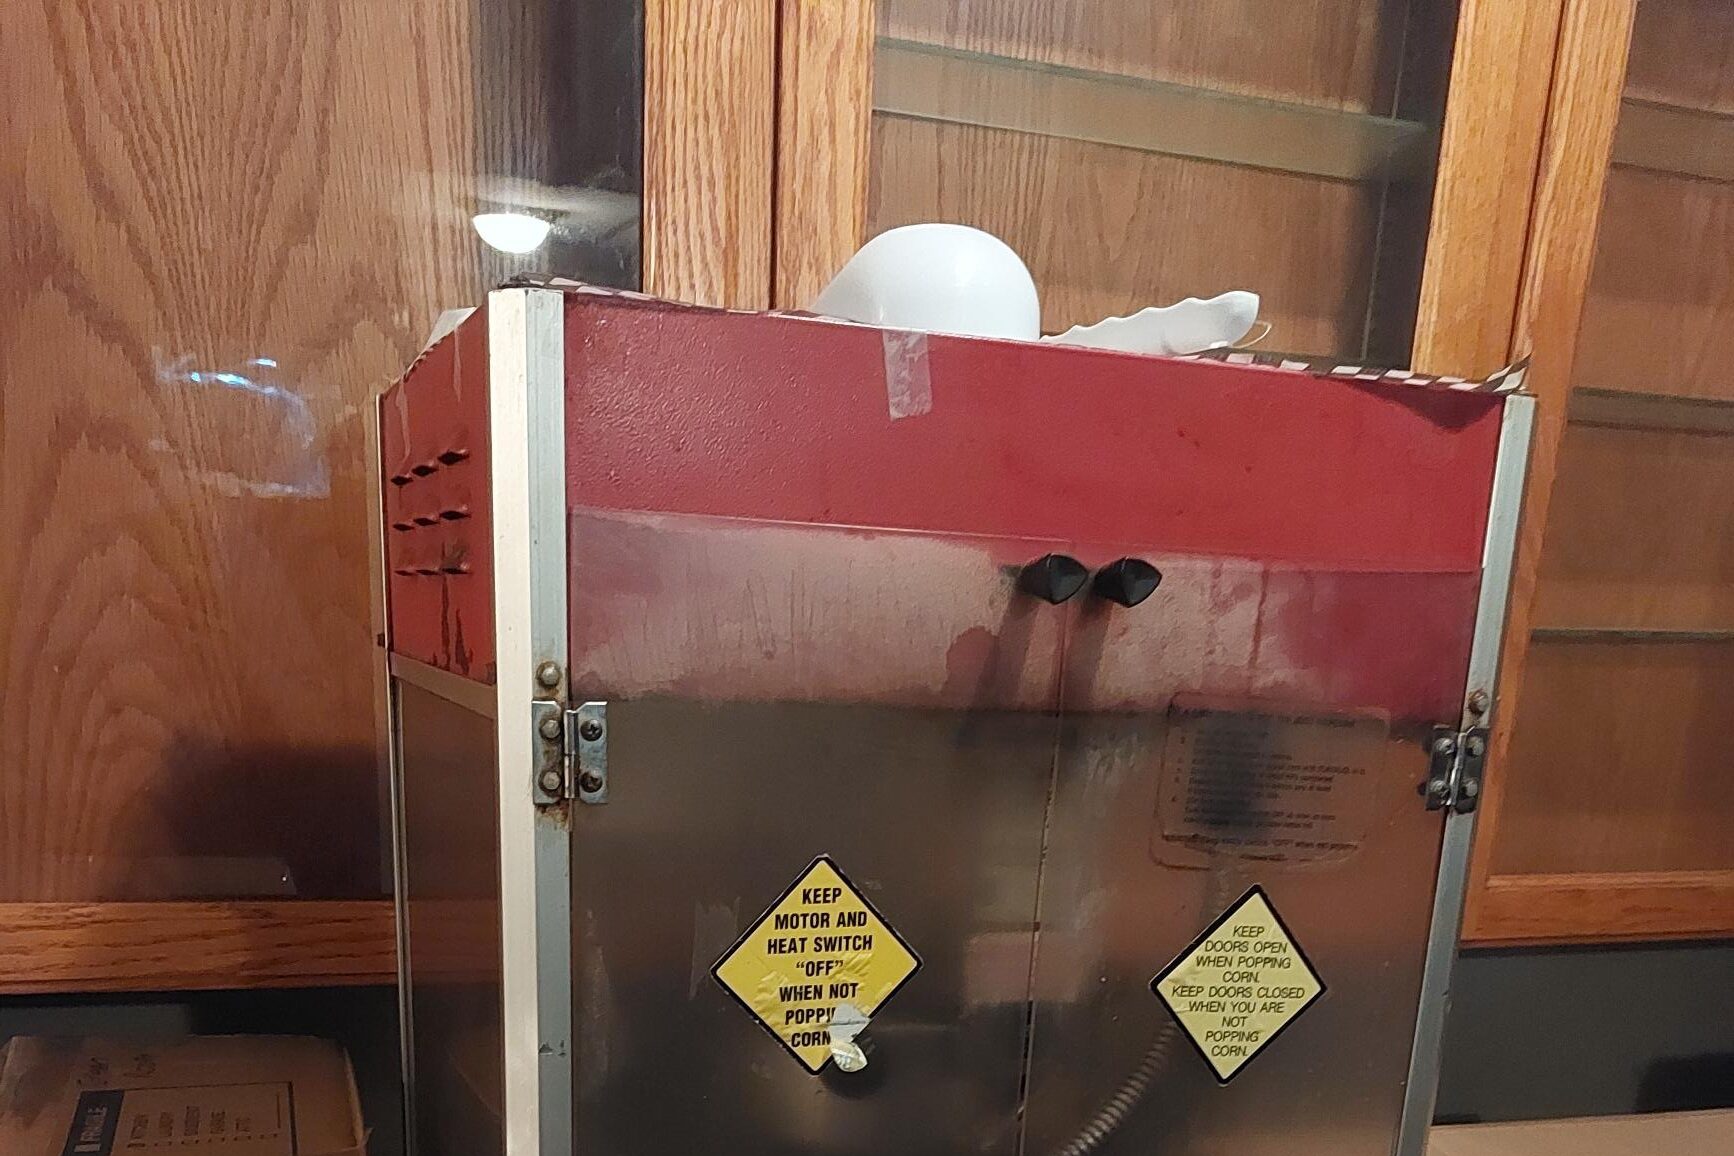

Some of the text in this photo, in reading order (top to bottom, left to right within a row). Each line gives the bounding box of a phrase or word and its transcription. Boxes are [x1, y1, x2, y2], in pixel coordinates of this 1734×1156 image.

[802, 888, 842, 904] KEEP
[775, 911, 867, 930] MOTOR AND
[1232, 926, 1265, 938] KEEP
[767, 935, 873, 954] HEAT SWITCH
[1205, 940, 1287, 954] DOORS OPEN
[1196, 956, 1291, 969] WHEN POPPING
[1222, 971, 1260, 983] CORN.
[779, 983, 859, 1002] WHEN NOT
[1171, 986, 1305, 998] KEEP DOORS CLOSED
[1189, 1001, 1285, 1013] WHEN YOU ARE
[1222, 1016, 1248, 1027] NOT
[791, 1032, 831, 1048] CORN
[1205, 1031, 1259, 1042] POPPING
